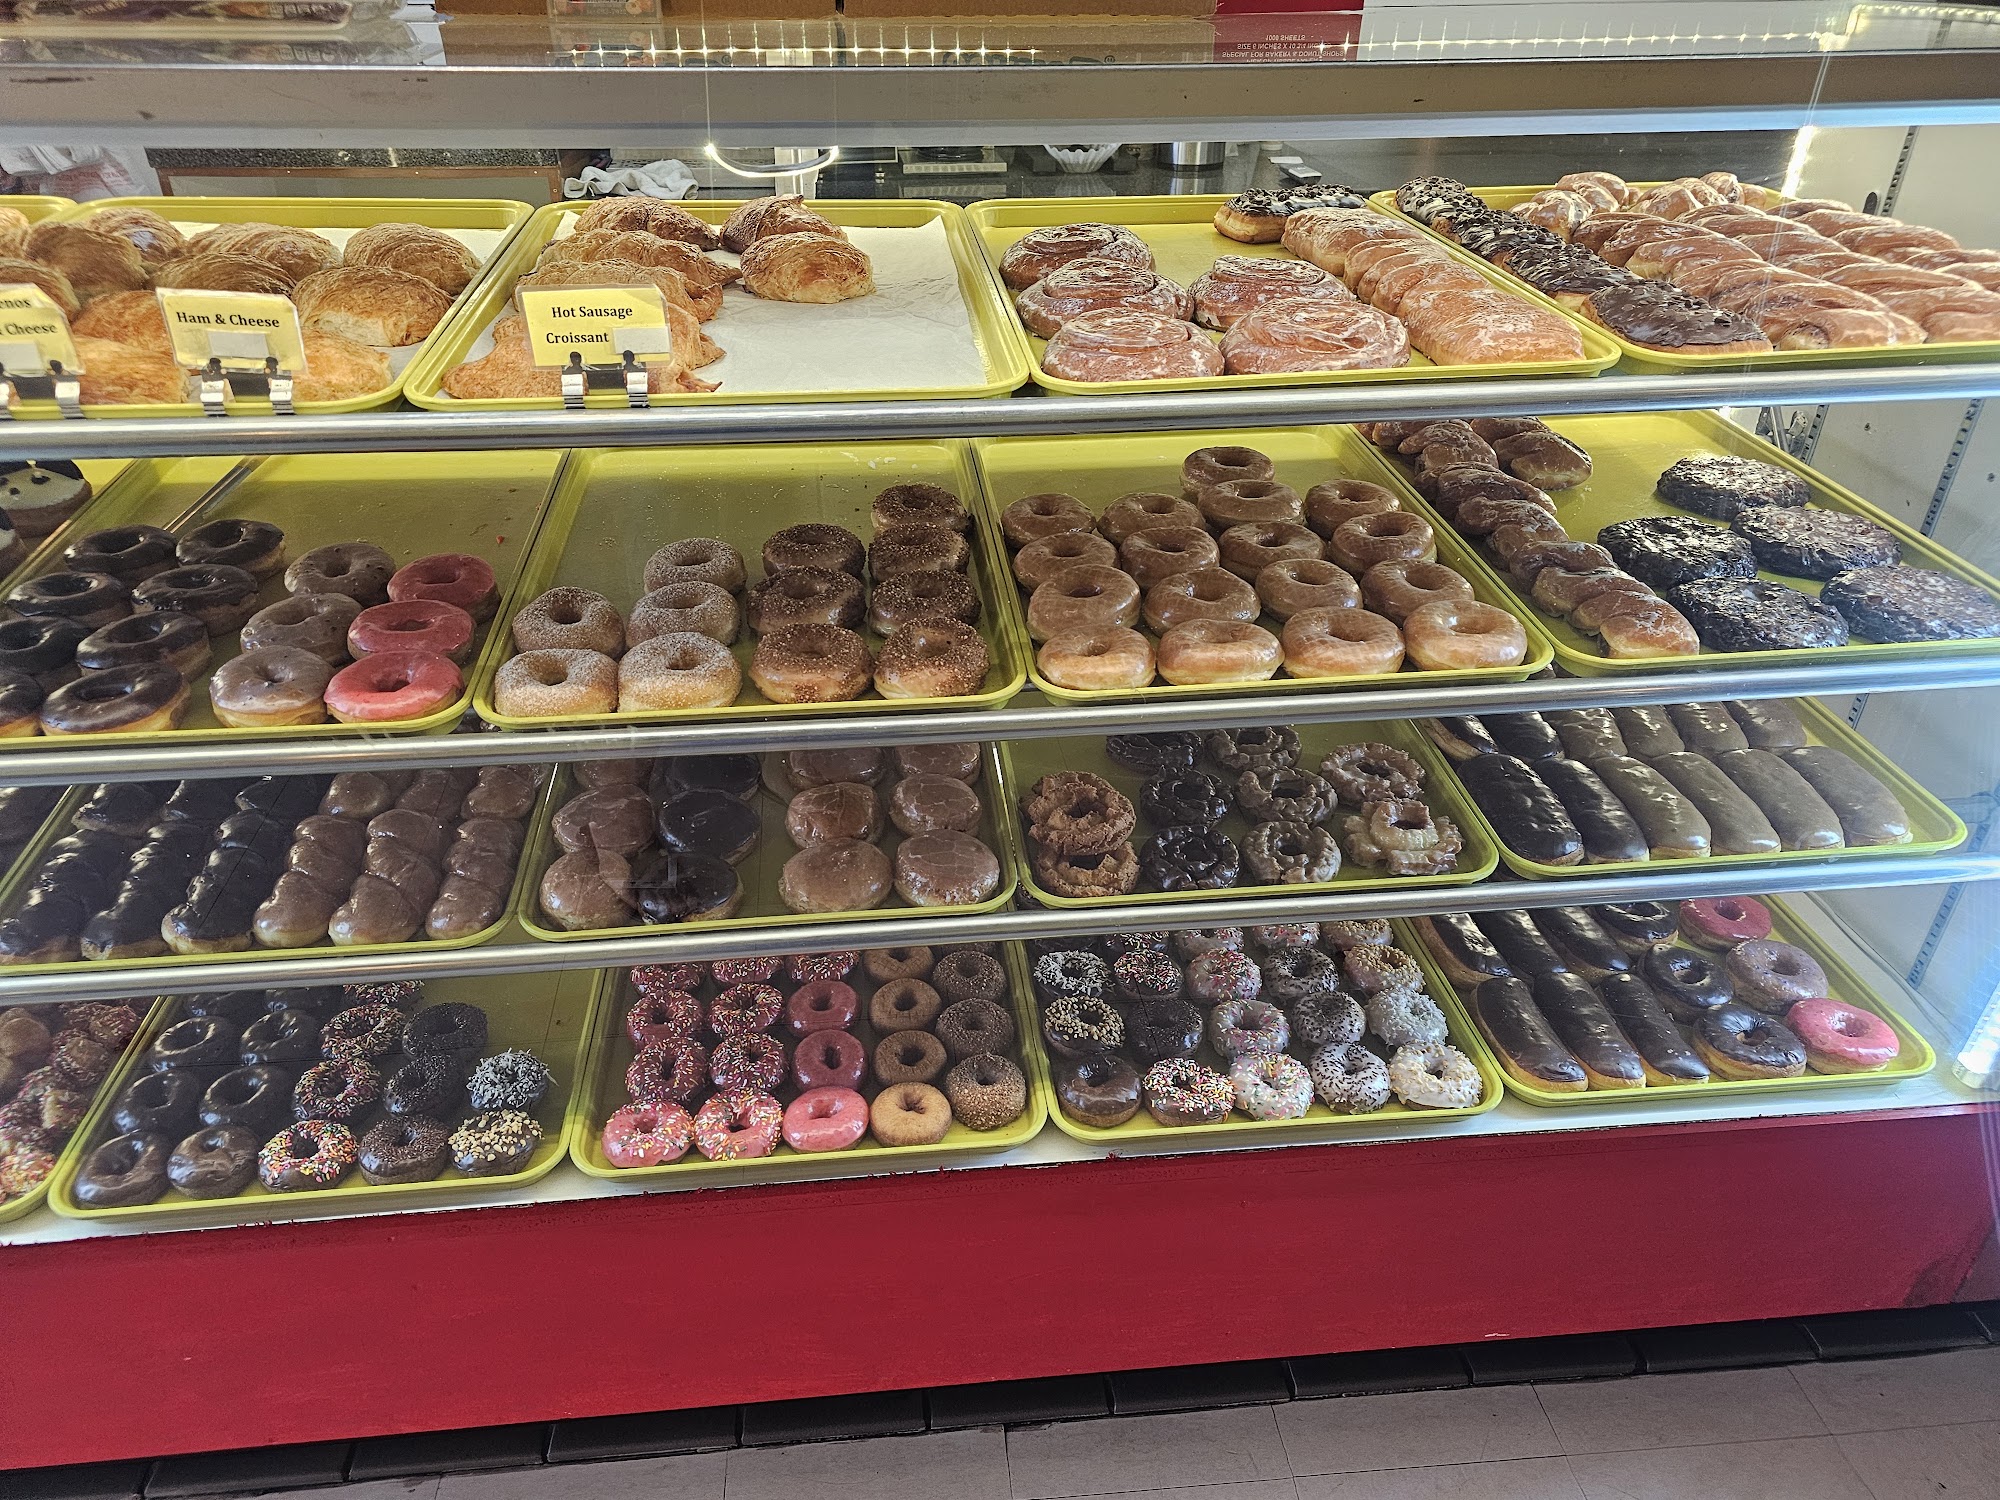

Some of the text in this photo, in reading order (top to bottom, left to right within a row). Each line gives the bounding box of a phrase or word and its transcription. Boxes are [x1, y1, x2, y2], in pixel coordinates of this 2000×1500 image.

[176, 311, 280, 328] Ham & Cheese
[551, 306, 633, 320] Hot Sausage
[5, 322, 59, 336] Cheese
[546, 332, 609, 344] Croissant
